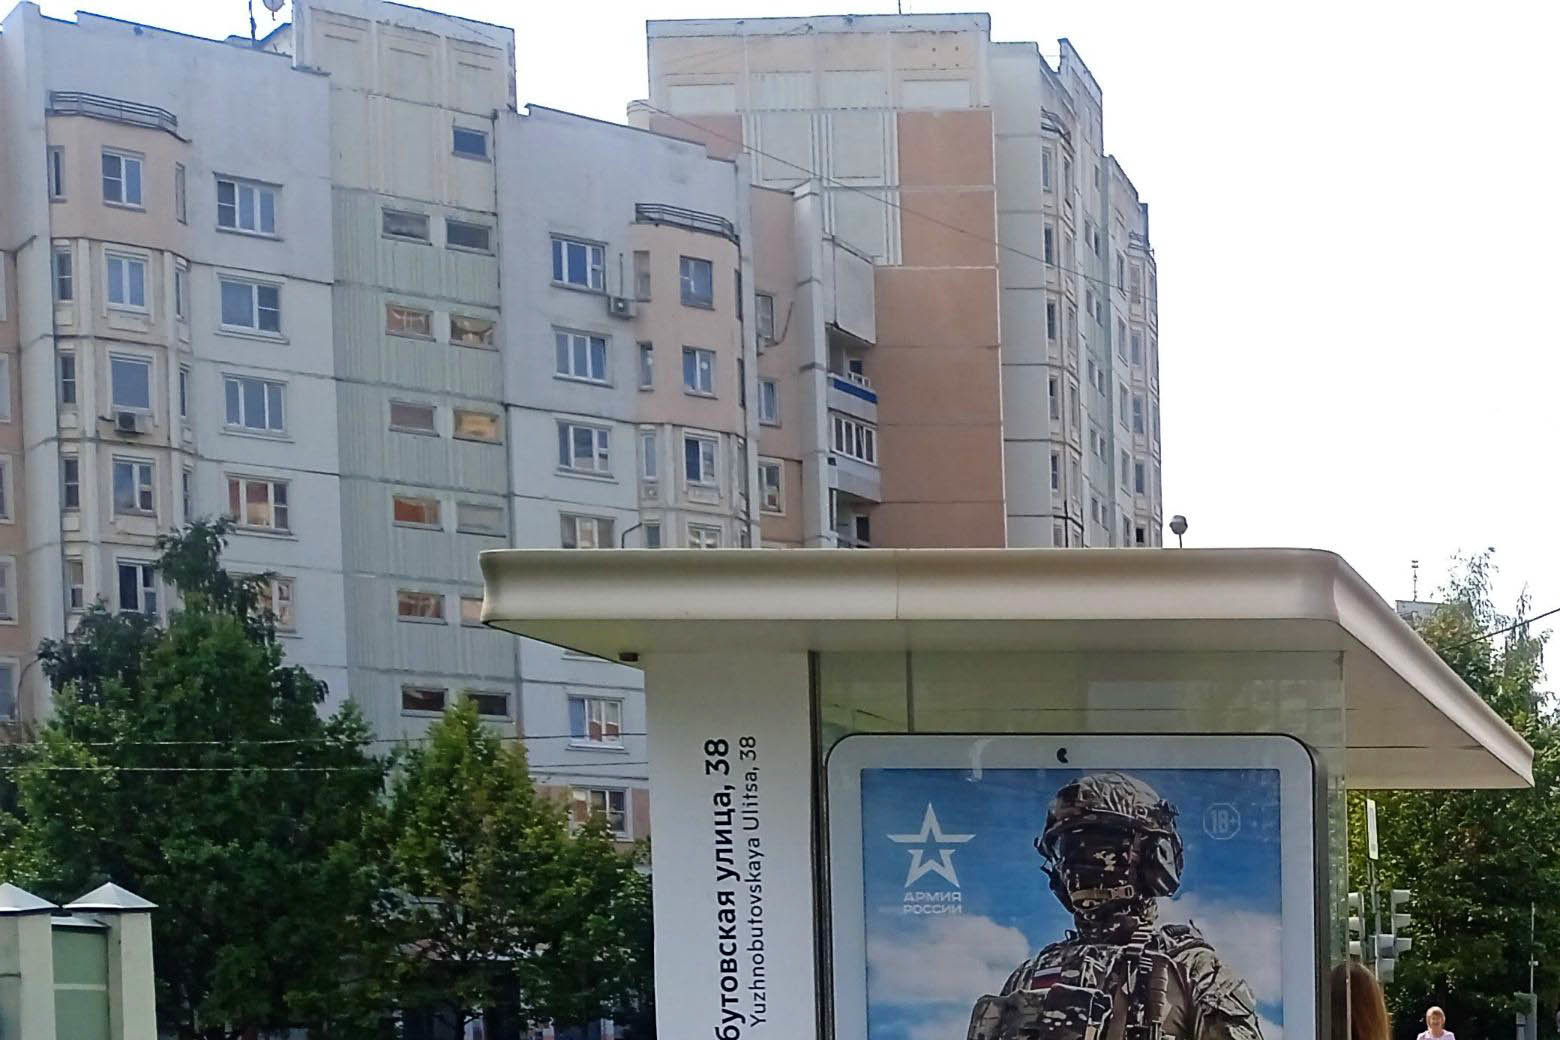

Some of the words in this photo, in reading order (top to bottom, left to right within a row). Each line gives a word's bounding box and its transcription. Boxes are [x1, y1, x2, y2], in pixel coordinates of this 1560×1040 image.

[704, 738, 730, 776] 38
[738, 736, 756, 761] 38
[741, 766, 760, 830] Ulitsa,
[713, 784, 740, 882] улица,
[903, 891, 962, 903] АРМИЯ
[903, 904, 962, 914] РОССИИ
[744, 837, 766, 1027] Yuzhnobutovskaya
